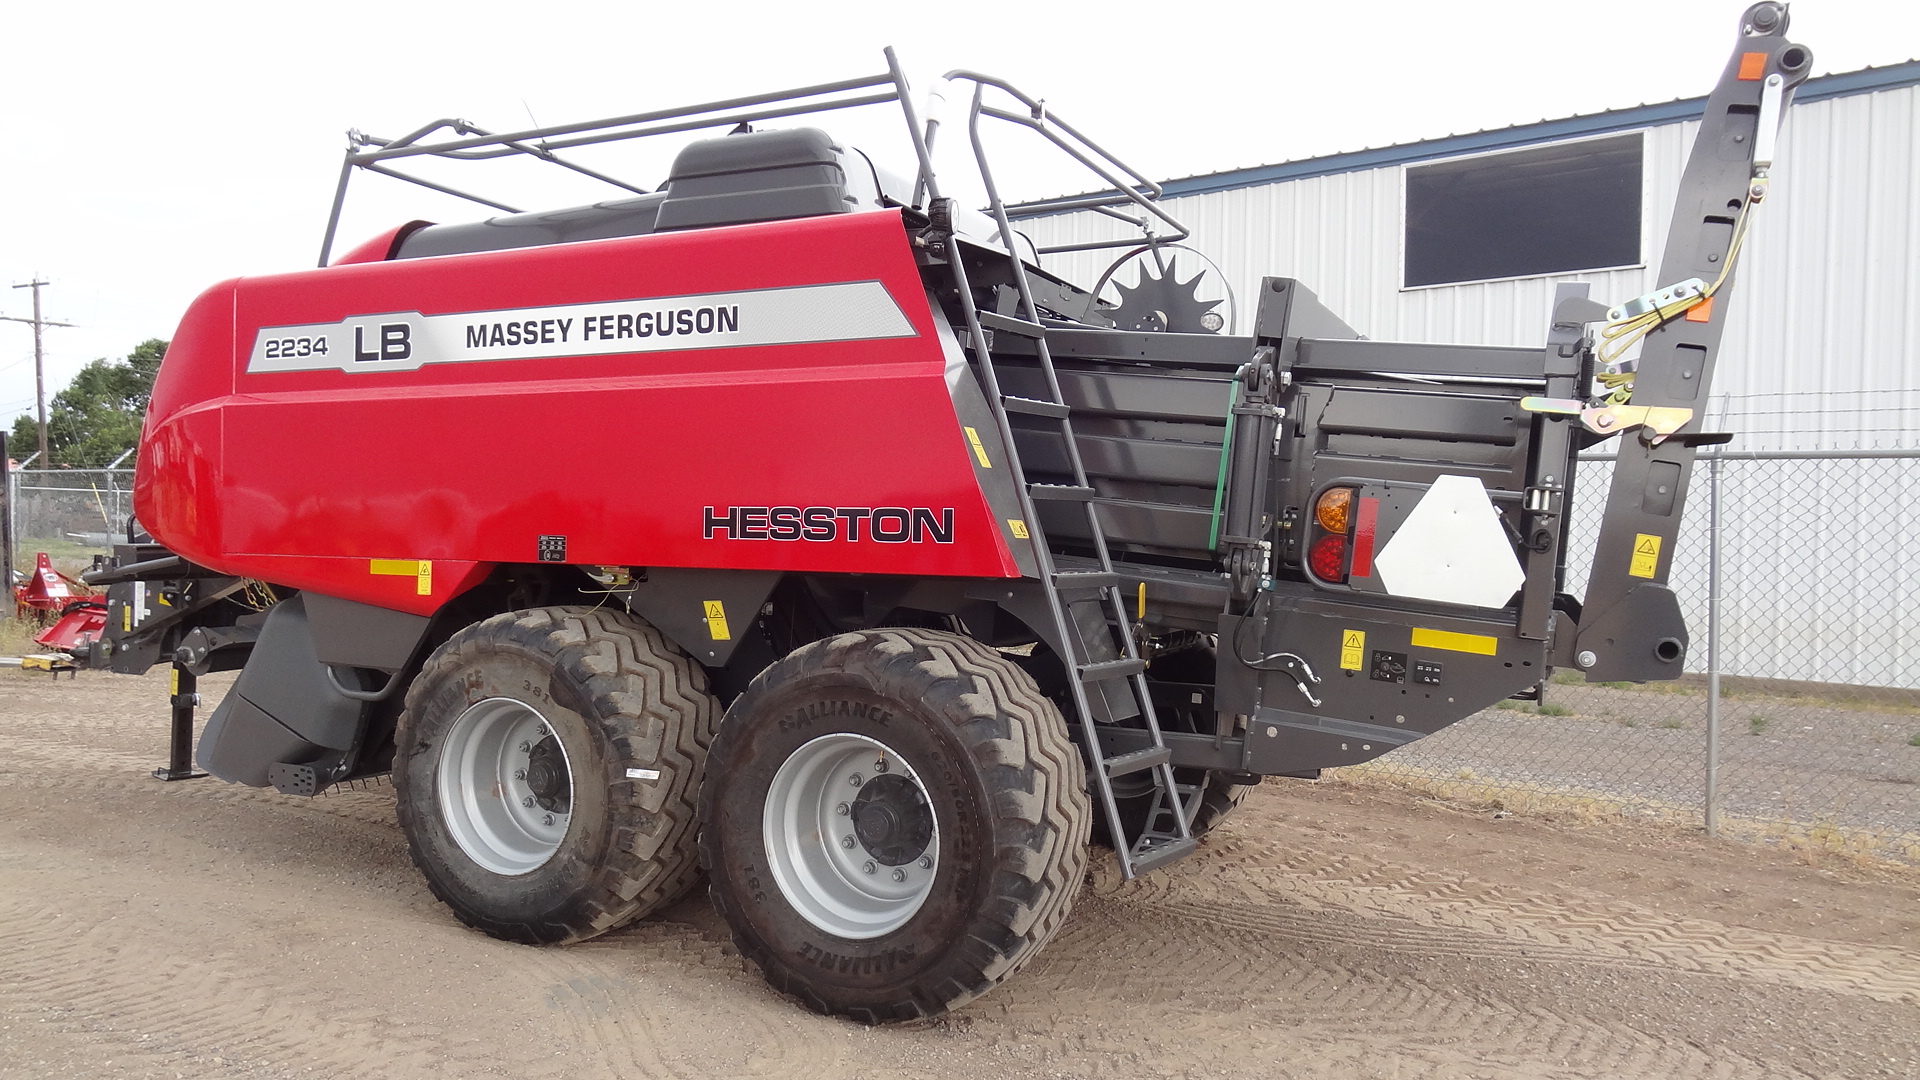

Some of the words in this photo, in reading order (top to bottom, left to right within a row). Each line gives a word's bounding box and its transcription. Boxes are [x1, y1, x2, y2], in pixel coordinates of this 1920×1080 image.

[354, 323, 412, 363] LB
[465, 318, 574, 348] MASSEY
[583, 306, 739, 341] FERGUSON
[266, 336, 329, 359] 2234
[703, 506, 955, 544] HESSTON
[522, 679, 550, 705] 381
[796, 700, 894, 731] ALLIANCE
[744, 864, 768, 905] 381
